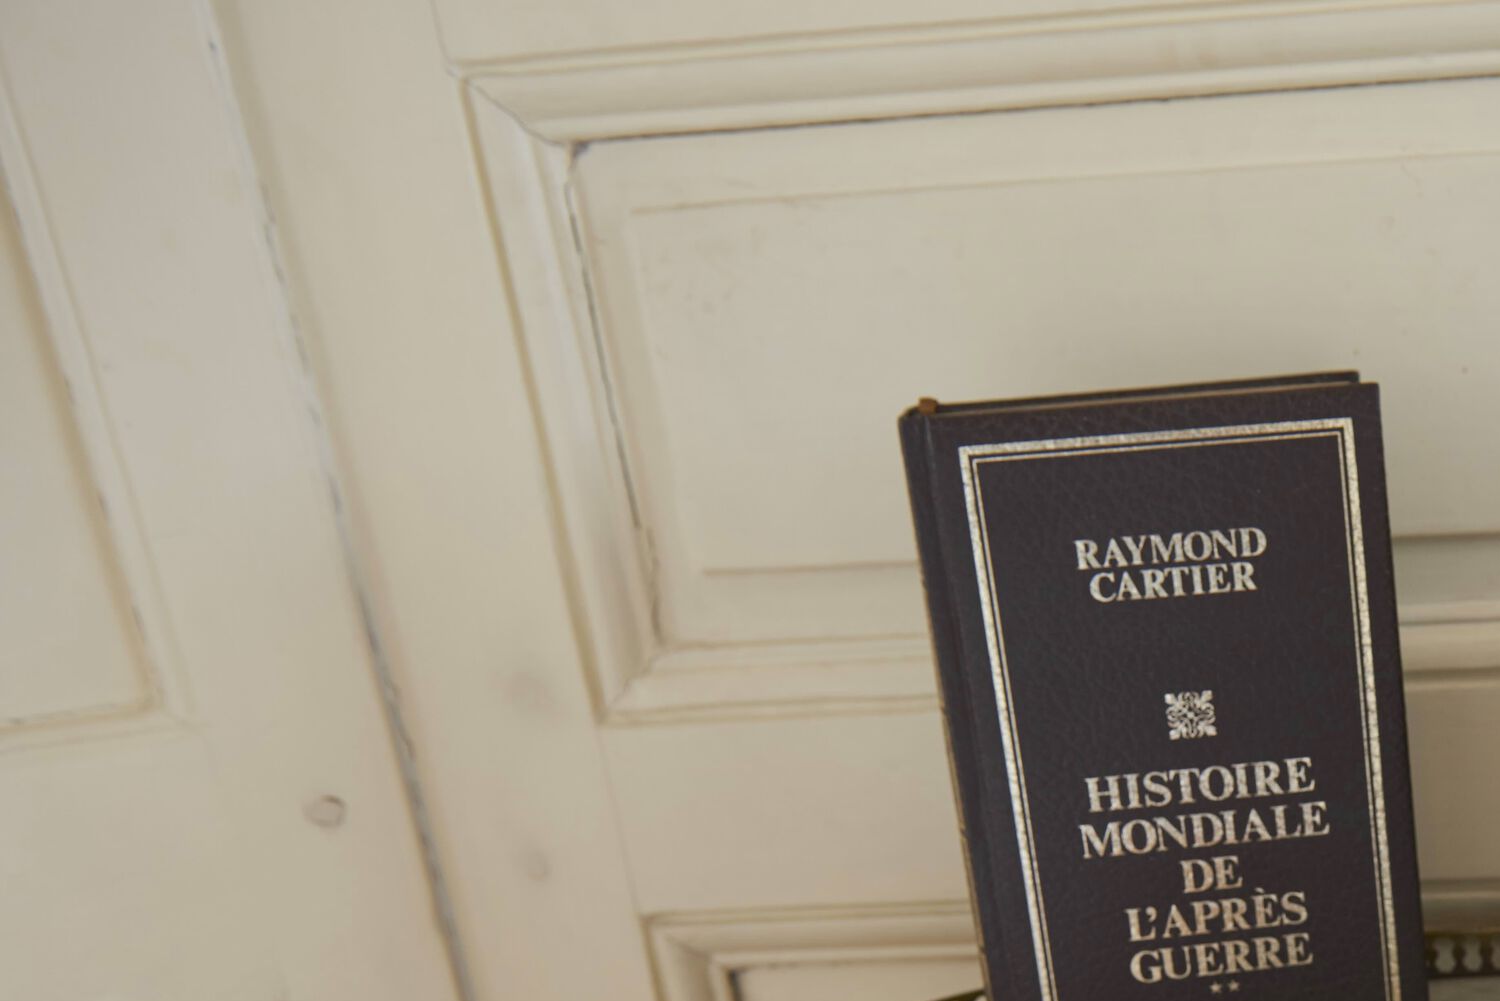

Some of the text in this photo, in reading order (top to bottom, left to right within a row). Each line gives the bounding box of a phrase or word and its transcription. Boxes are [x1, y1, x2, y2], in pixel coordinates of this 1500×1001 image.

[1074, 527, 1268, 571] RAYMOND
[1089, 561, 1257, 603] CARTIER
[1084, 757, 1316, 813] HISTOIRE
[1079, 801, 1330, 859] MONDIALE
[1179, 855, 1243, 894] DE
[1125, 887, 1308, 942] L'APRÈS
[1128, 933, 1314, 985] GUERRE
